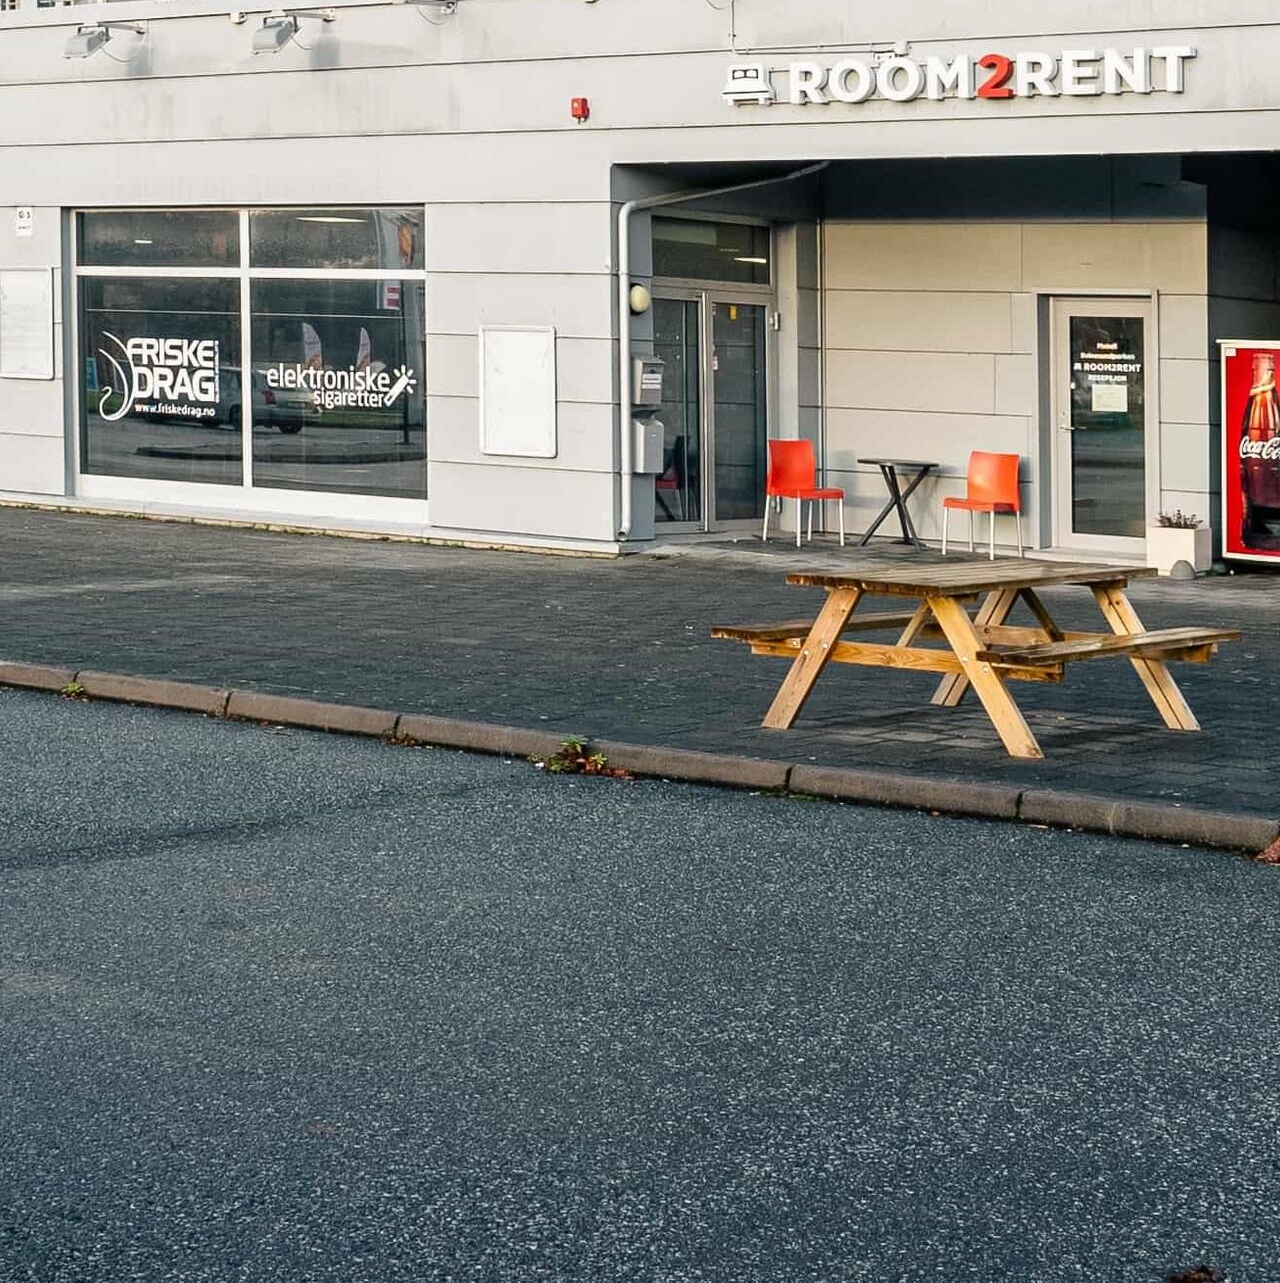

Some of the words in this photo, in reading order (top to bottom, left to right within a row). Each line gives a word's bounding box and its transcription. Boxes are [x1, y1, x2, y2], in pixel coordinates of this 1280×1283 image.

[788, 45, 1197, 105] ROOM2RENT
[126, 337, 214, 368] FRISKE
[266, 363, 391, 392] elektroniske
[1083, 363, 1141, 372] ROOM2RENT
[132, 366, 215, 402] DRAG
[313, 387, 384, 409] sigaretter
[134, 403, 216, 418] www.friskedrag.no
